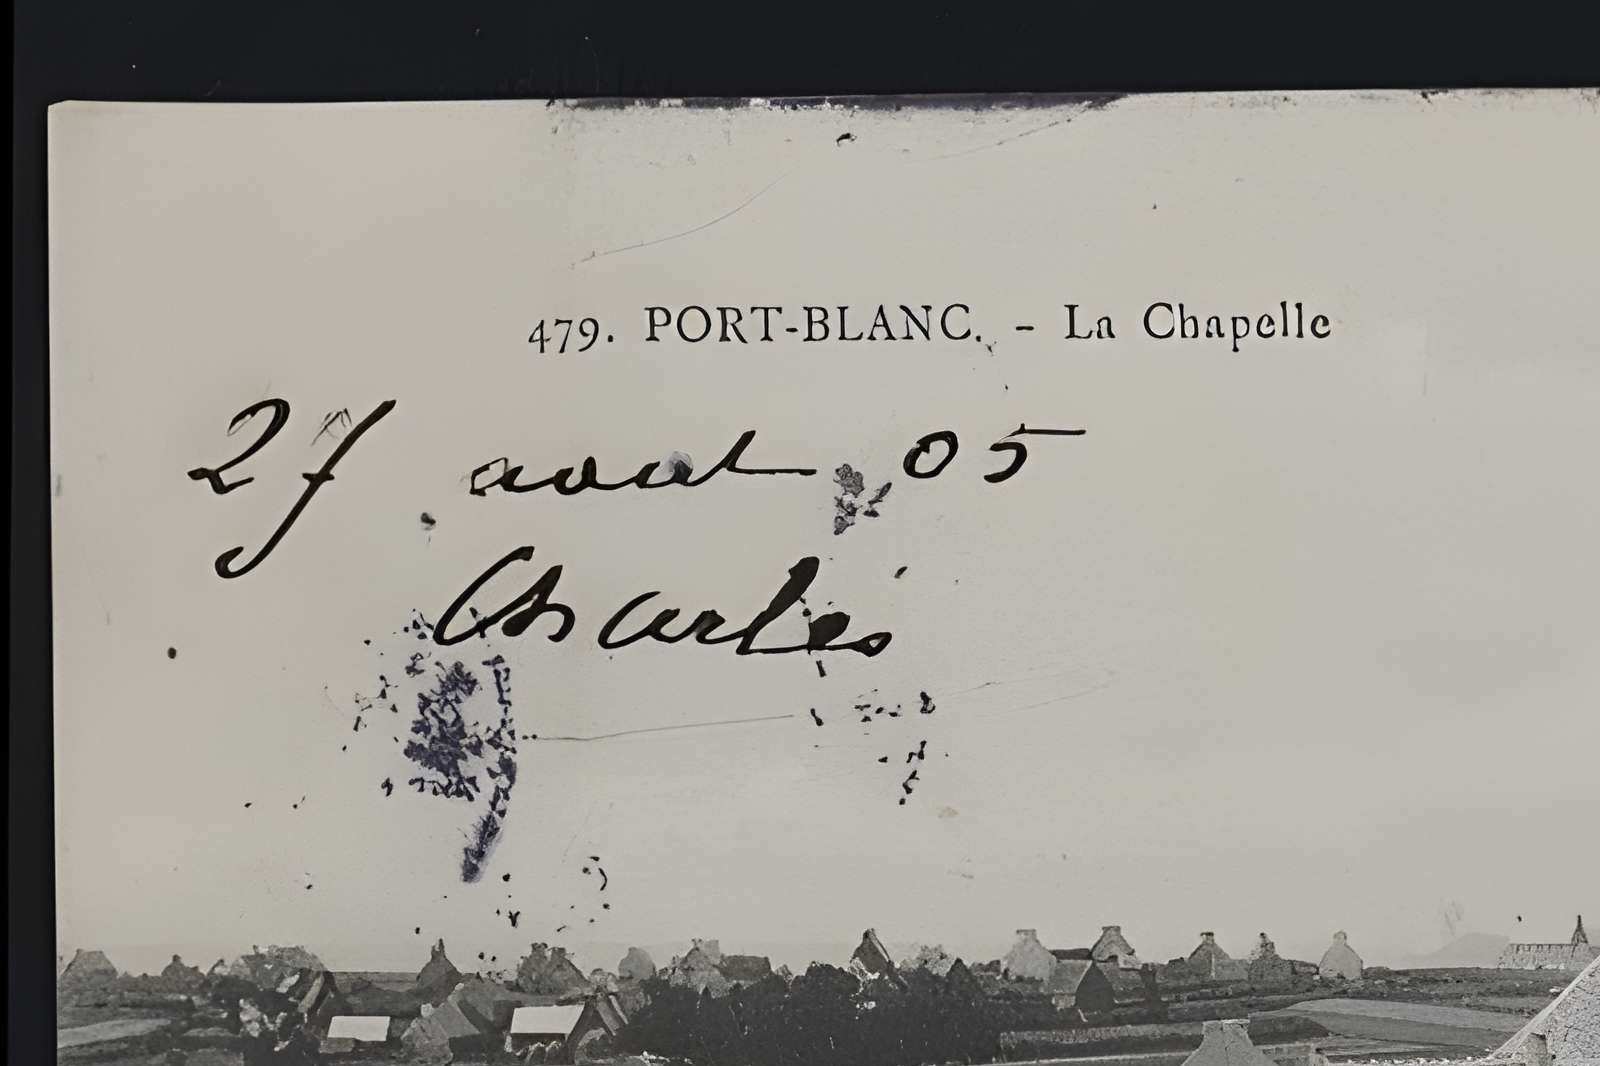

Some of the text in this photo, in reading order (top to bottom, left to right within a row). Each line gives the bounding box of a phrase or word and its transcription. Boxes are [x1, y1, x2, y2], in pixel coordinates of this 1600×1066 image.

[527, 316, 615, 355] 479.
[643, 302, 983, 345] PORT-BLANC.
[1062, 303, 1117, 341] La
[1142, 299, 1332, 354] Chapelle
[901, 421, 1088, 485] 05
[431, 544, 894, 659] Charles
